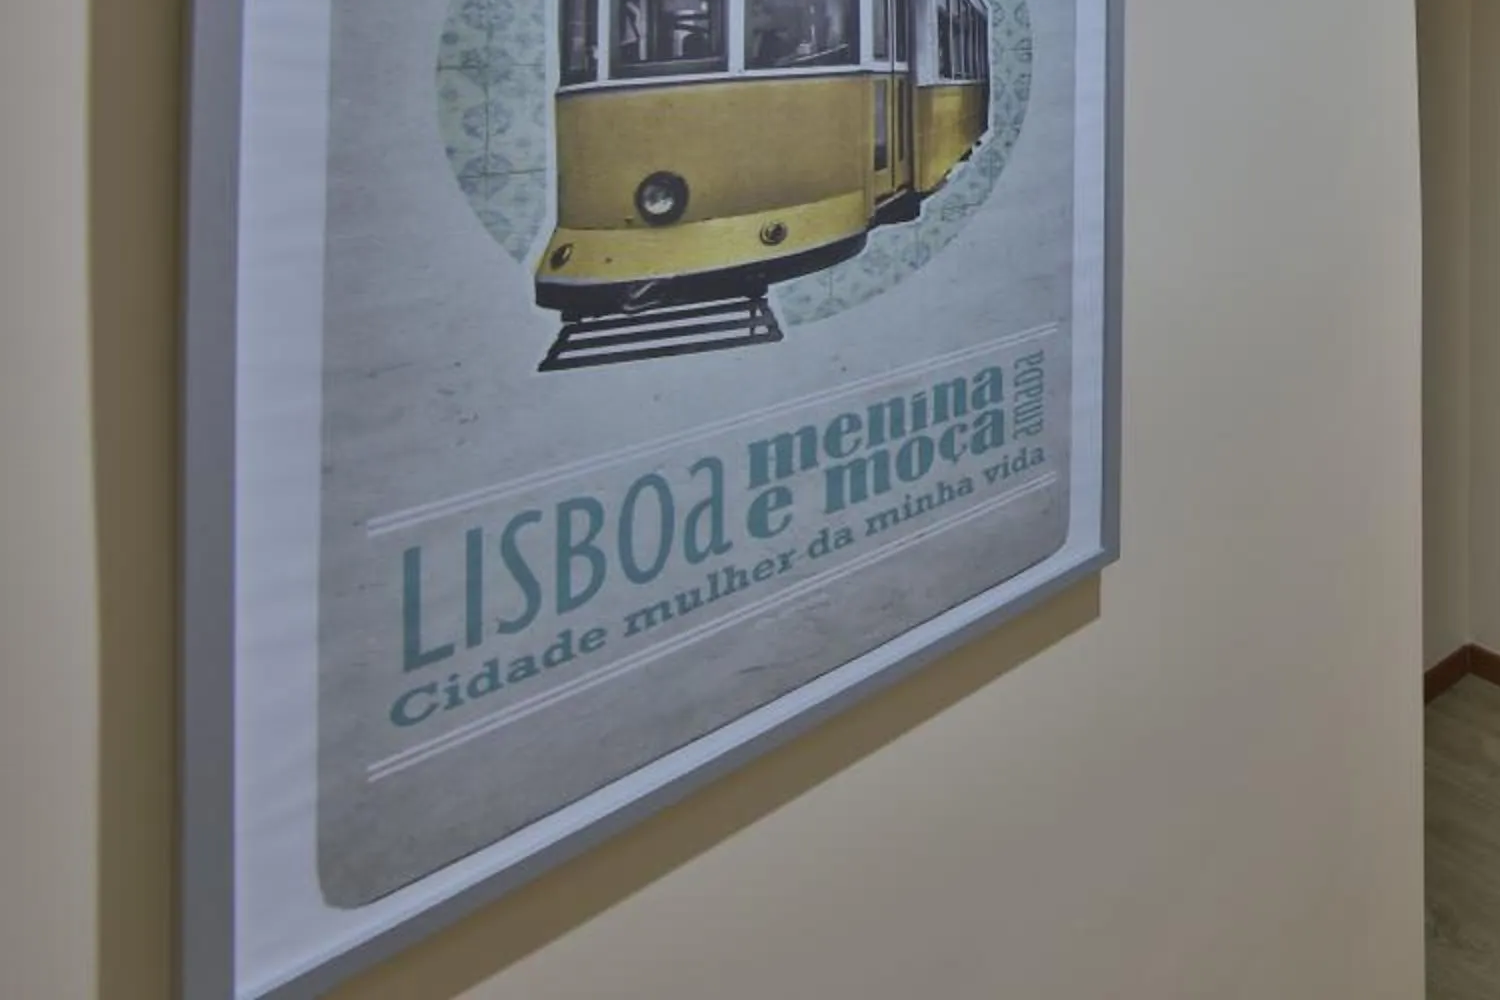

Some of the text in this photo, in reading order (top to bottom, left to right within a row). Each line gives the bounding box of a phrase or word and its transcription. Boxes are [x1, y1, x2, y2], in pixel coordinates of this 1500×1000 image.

[746, 408, 1005, 539] e moça
[747, 365, 1004, 490] menina
[389, 446, 1046, 728] Cidade mulher da minha vida
